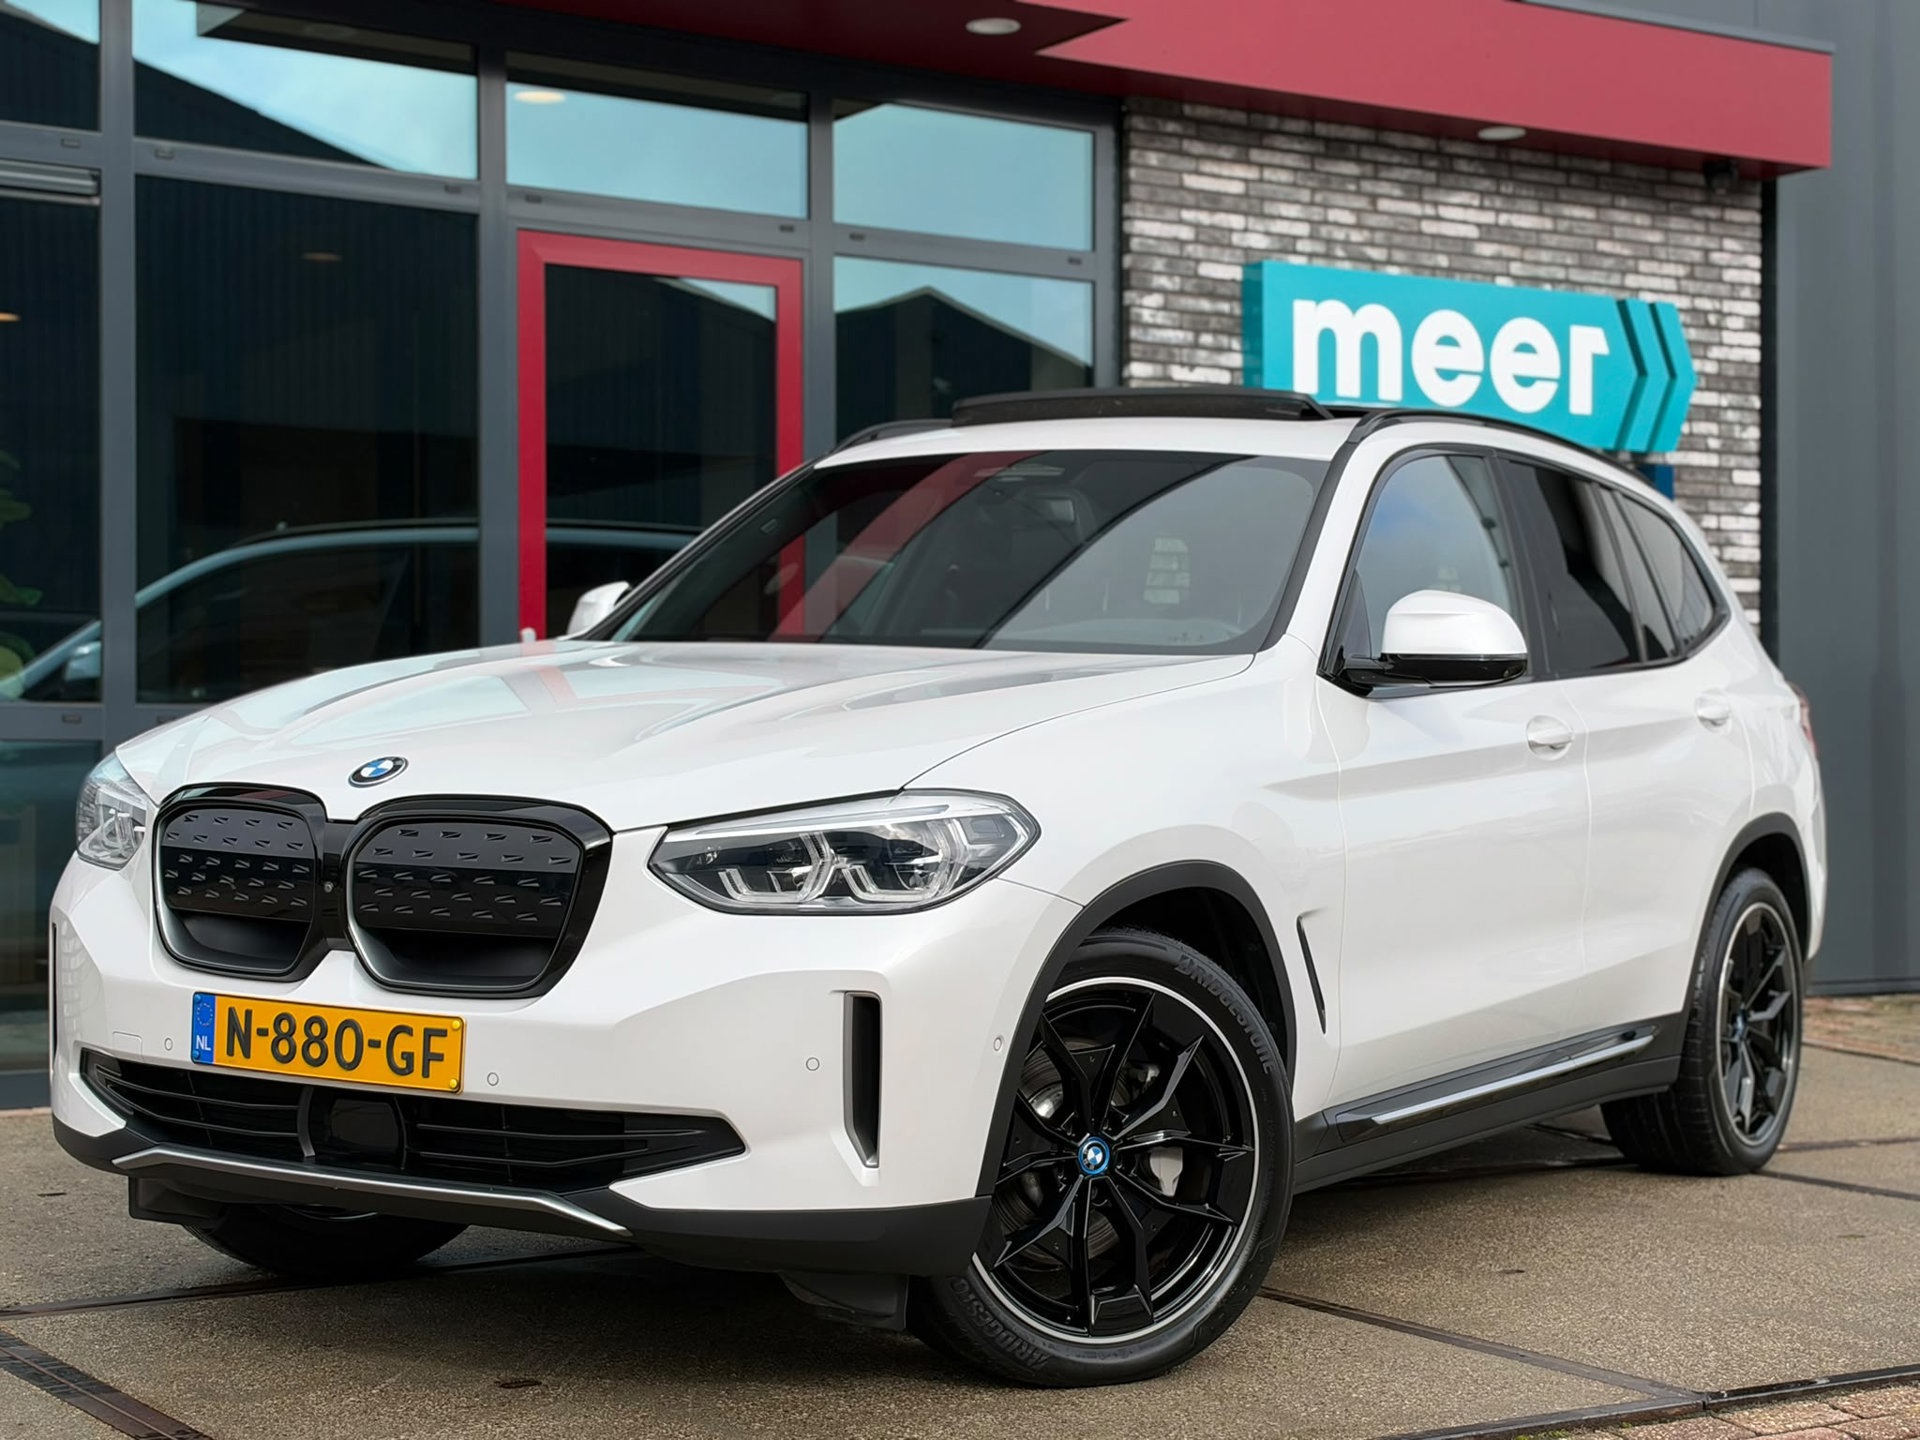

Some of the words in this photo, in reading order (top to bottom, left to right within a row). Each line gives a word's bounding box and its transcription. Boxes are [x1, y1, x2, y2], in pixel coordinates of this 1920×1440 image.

[1292, 299, 1610, 416] meer
[195, 1035, 211, 1052] NL
[226, 1006, 448, 1079] N-880-GF
[1174, 953, 1276, 1075] BRIDGESTONE
[944, 1275, 1051, 1371] BRIDGESTO
